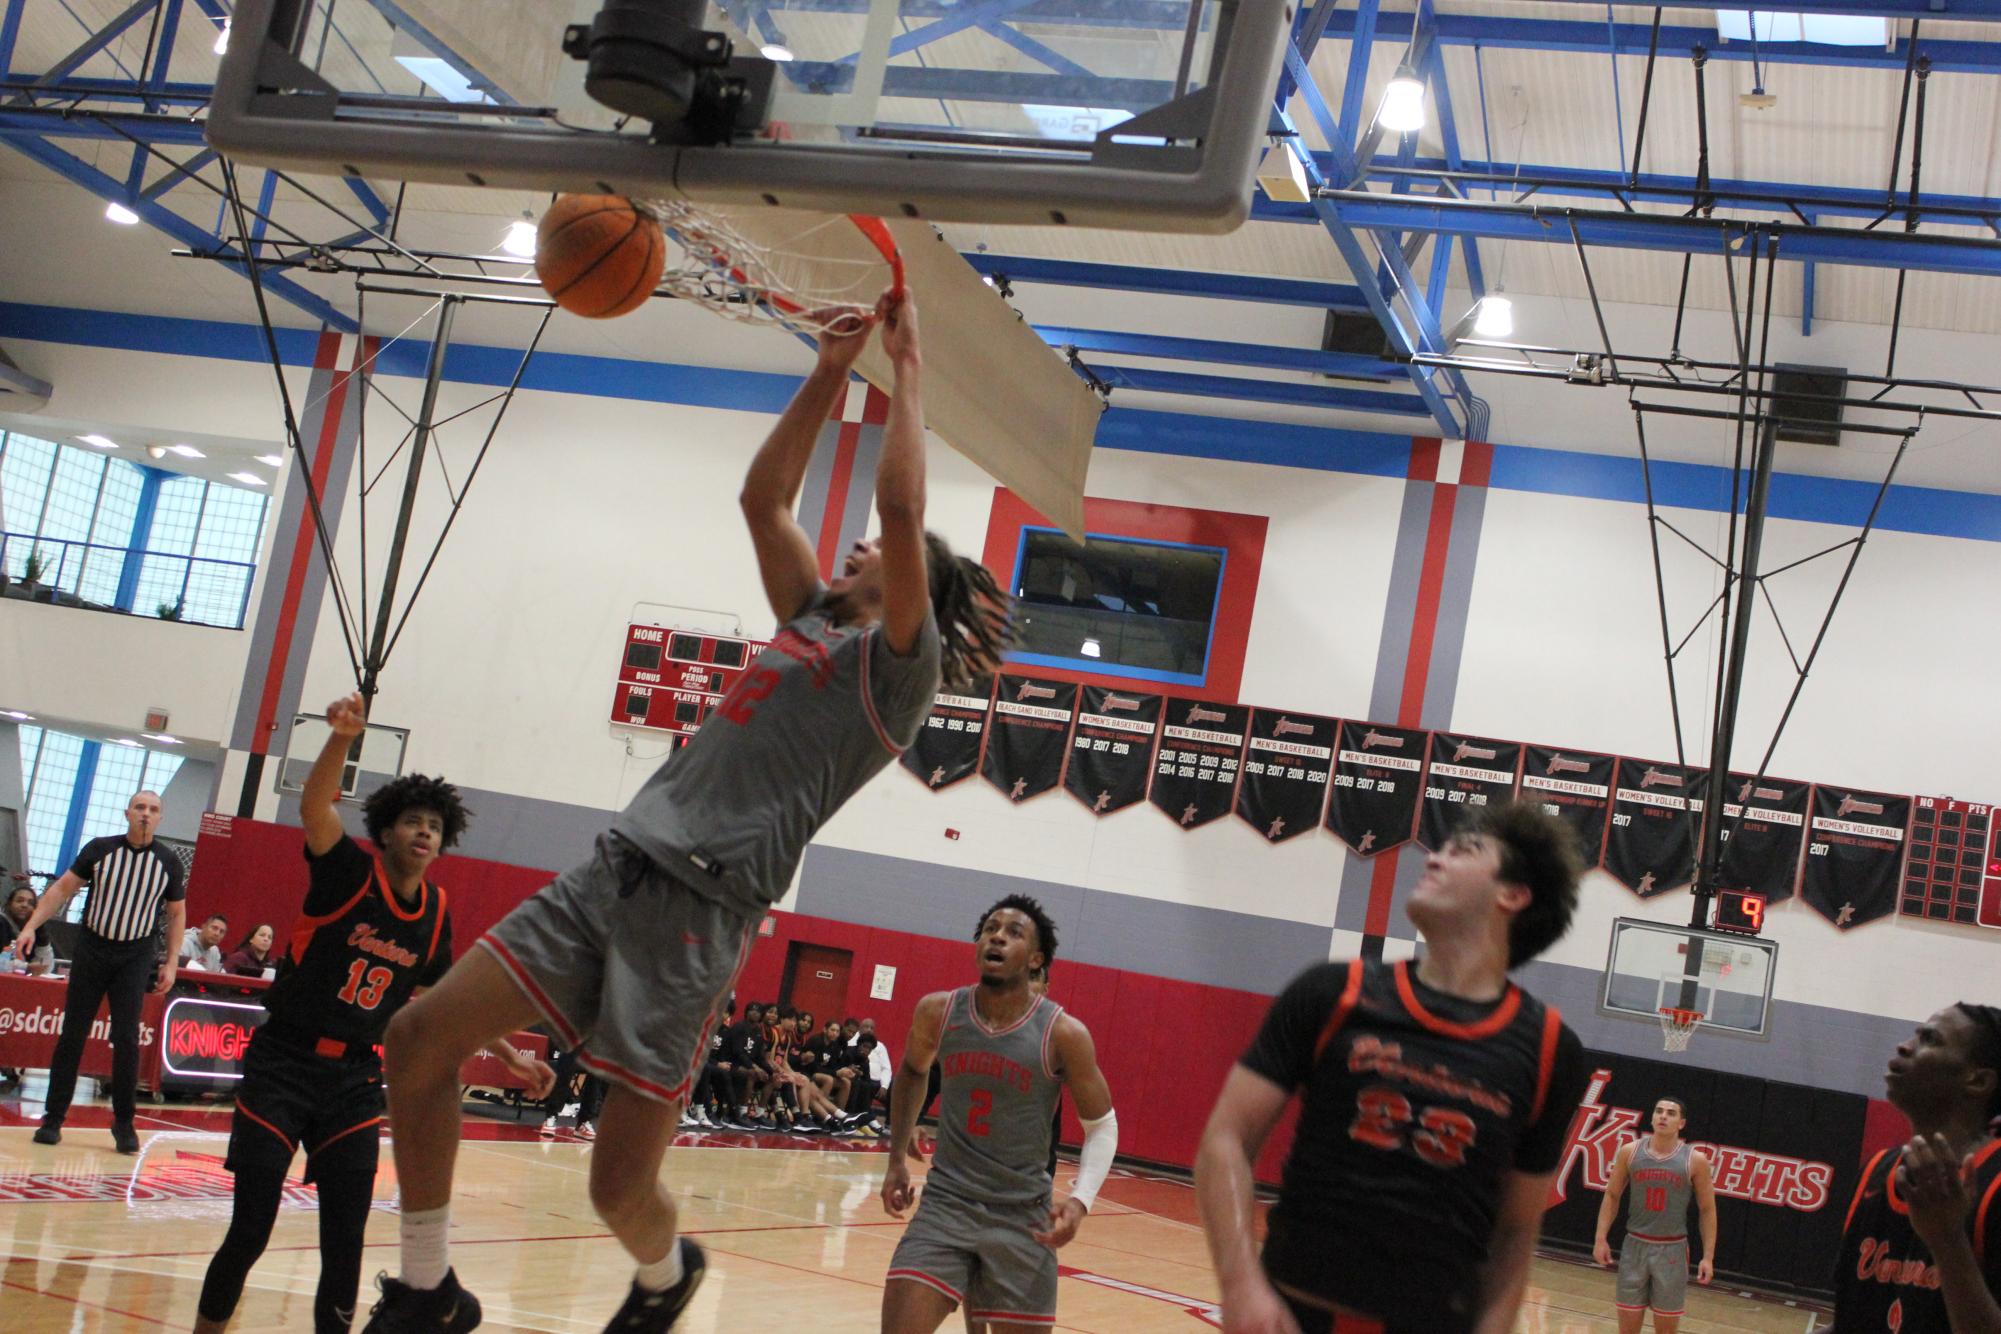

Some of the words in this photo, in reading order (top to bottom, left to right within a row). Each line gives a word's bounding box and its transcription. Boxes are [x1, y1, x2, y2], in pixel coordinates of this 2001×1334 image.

[633, 628, 663, 642] HOME
[635, 671, 661, 682] BONUS
[680, 672, 708, 684] PERIOD
[629, 686, 652, 696] FOULS
[673, 692, 701, 704] PLAYER
[705, 696, 720, 706] FOU
[936, 695, 971, 707] ASEBALL
[630, 716, 646, 725] WON
[1034, 707, 1069, 720] VOLLEYBALL
[1082, 715, 1111, 726] WOMEN'S
[1111, 719, 1151, 732] BASKETBALL
[1168, 727, 1189, 737] MEN'S
[1191, 730, 1237, 744] BASKETBALL
[1093, 740, 1110, 752] 2017
[1112, 742, 1129, 755] 2018
[1256, 740, 1277, 750] MEN'S
[1279, 742, 1324, 757] BASKETBALL
[1159, 749, 1176, 761] 2001
[1178, 752, 1198, 764] 2005
[1200, 755, 1219, 768] 2009
[1221, 758, 1239, 770] 2012
[1345, 752, 1366, 762] MEN'S
[1368, 756, 1414, 769] BASKETBALL
[1158, 763, 1176, 775] 2014
[1178, 766, 1195, 778] 2016
[1198, 768, 1215, 781] 2017
[1246, 761, 1264, 774] 2009
[1267, 764, 1284, 777] 2017
[1287, 768, 1304, 780] 2018
[1306, 770, 1327, 784] 2020
[1434, 764, 1456, 775] MEN'S
[1459, 768, 1506, 782] BASKETBALL
[1334, 774, 1354, 787] 2009
[1356, 778, 1374, 790] 2017
[1529, 778, 1552, 788] MEN'S
[1554, 781, 1602, 795] BASKETBALL
[1425, 786, 1445, 800] 2009
[1448, 790, 1466, 803] 2017
[1469, 794, 1487, 806] 2018
[1618, 790, 1652, 802] WOMEN'S
[1655, 795, 1701, 810] VOLLEYLL
[1920, 798, 1934, 808] NO
[1948, 801, 1956, 811] F
[1968, 804, 1987, 815] PTS
[1612, 813, 1632, 827] 2017
[1753, 810, 1800, 824] VOLLEYBALL
[1817, 819, 1850, 832] WOMEN'S
[1852, 824, 1898, 838] VOLLEYBALL
[1810, 842, 1829, 856] 2017
[1742, 897, 1761, 929] 9
[337, 957, 393, 1010] 13
[169, 1019, 255, 1061] KNIGH
[964, 1088, 993, 1137] 2
[1645, 1186, 1667, 1213] 10
